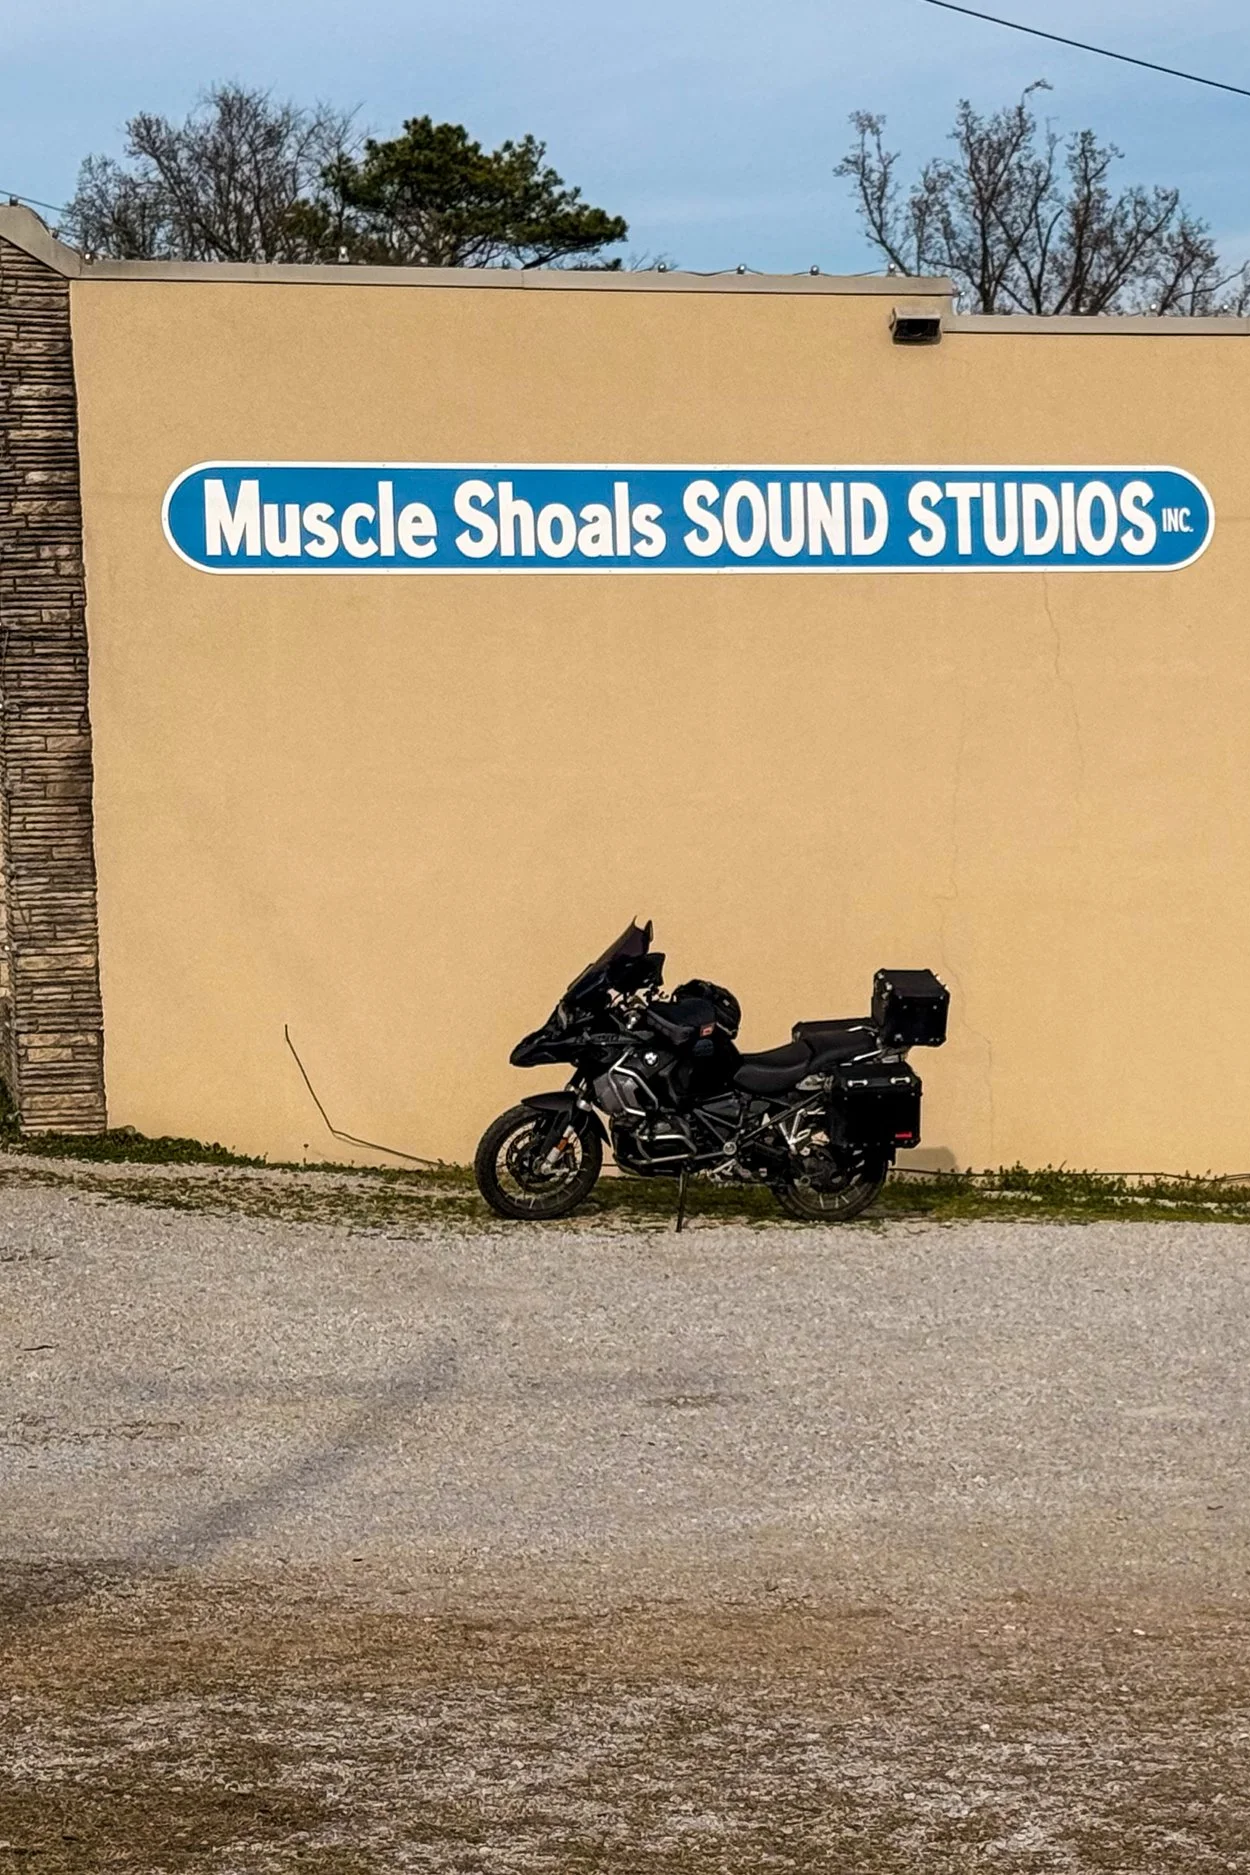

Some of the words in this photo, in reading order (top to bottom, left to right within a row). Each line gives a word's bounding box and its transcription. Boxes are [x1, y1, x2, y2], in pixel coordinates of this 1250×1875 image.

[205, 480, 437, 558] Muscle
[455, 480, 667, 558] Shoals
[683, 480, 889, 557] SOUND
[908, 481, 1156, 556] STUDIOS
[1163, 508, 1192, 533] INC.
